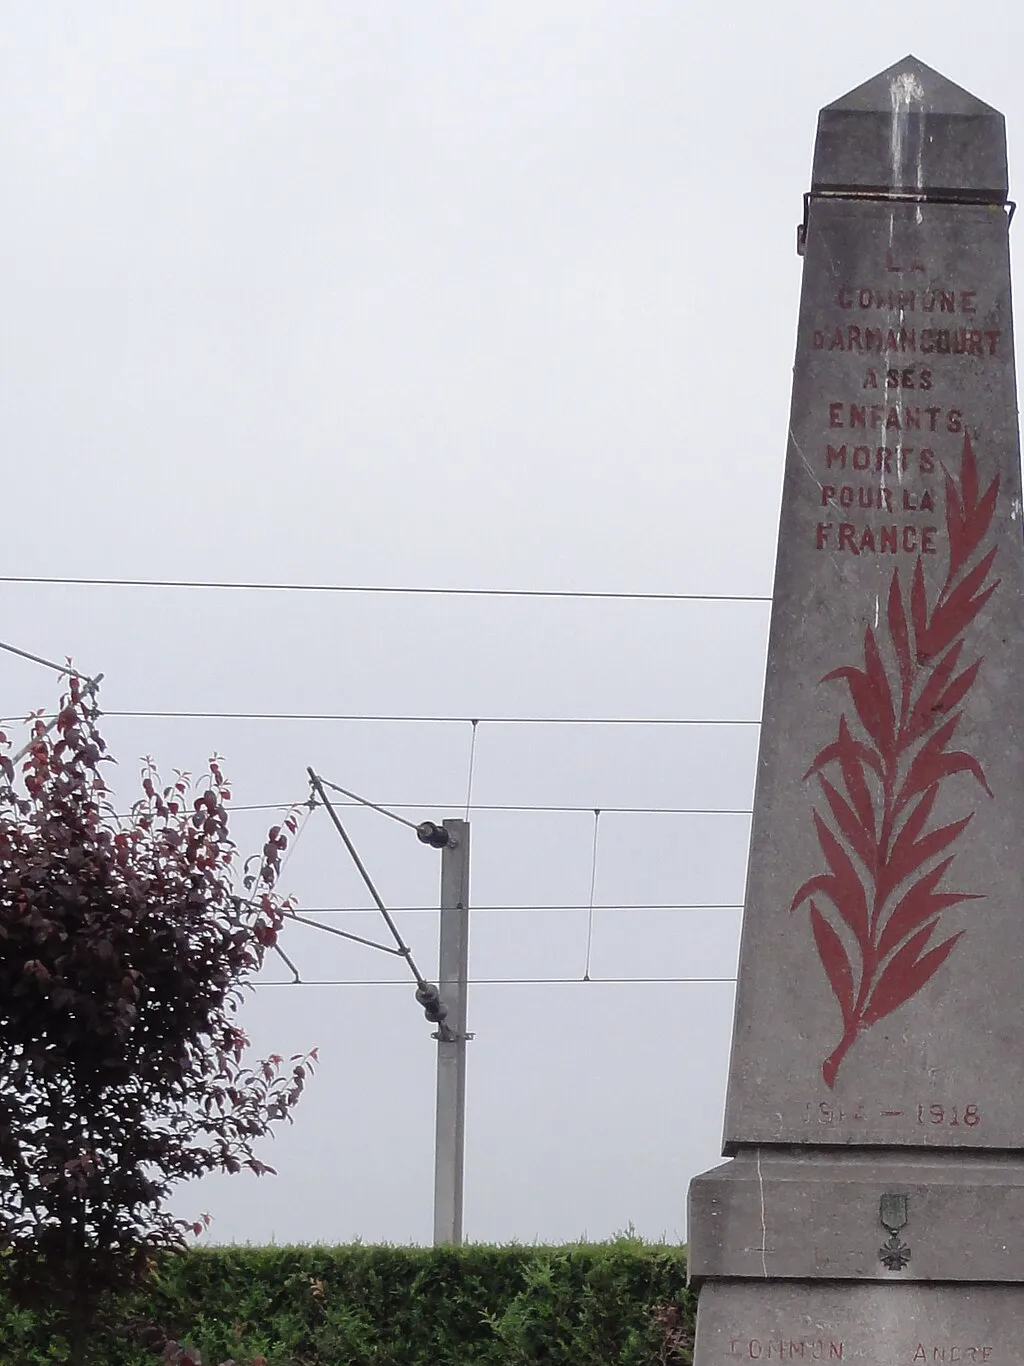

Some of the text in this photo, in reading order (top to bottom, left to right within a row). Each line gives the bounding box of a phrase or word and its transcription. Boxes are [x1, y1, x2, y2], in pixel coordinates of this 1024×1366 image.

[838, 288, 977, 314] COMMUNE
[886, 368, 932, 390] SES
[828, 402, 963, 433] ENFANTS
[826, 444, 935, 474] MORTS
[821, 486, 935, 512] POUR LA
[816, 522, 937, 555] FRANCE
[916, 1103, 981, 1127] 1918
